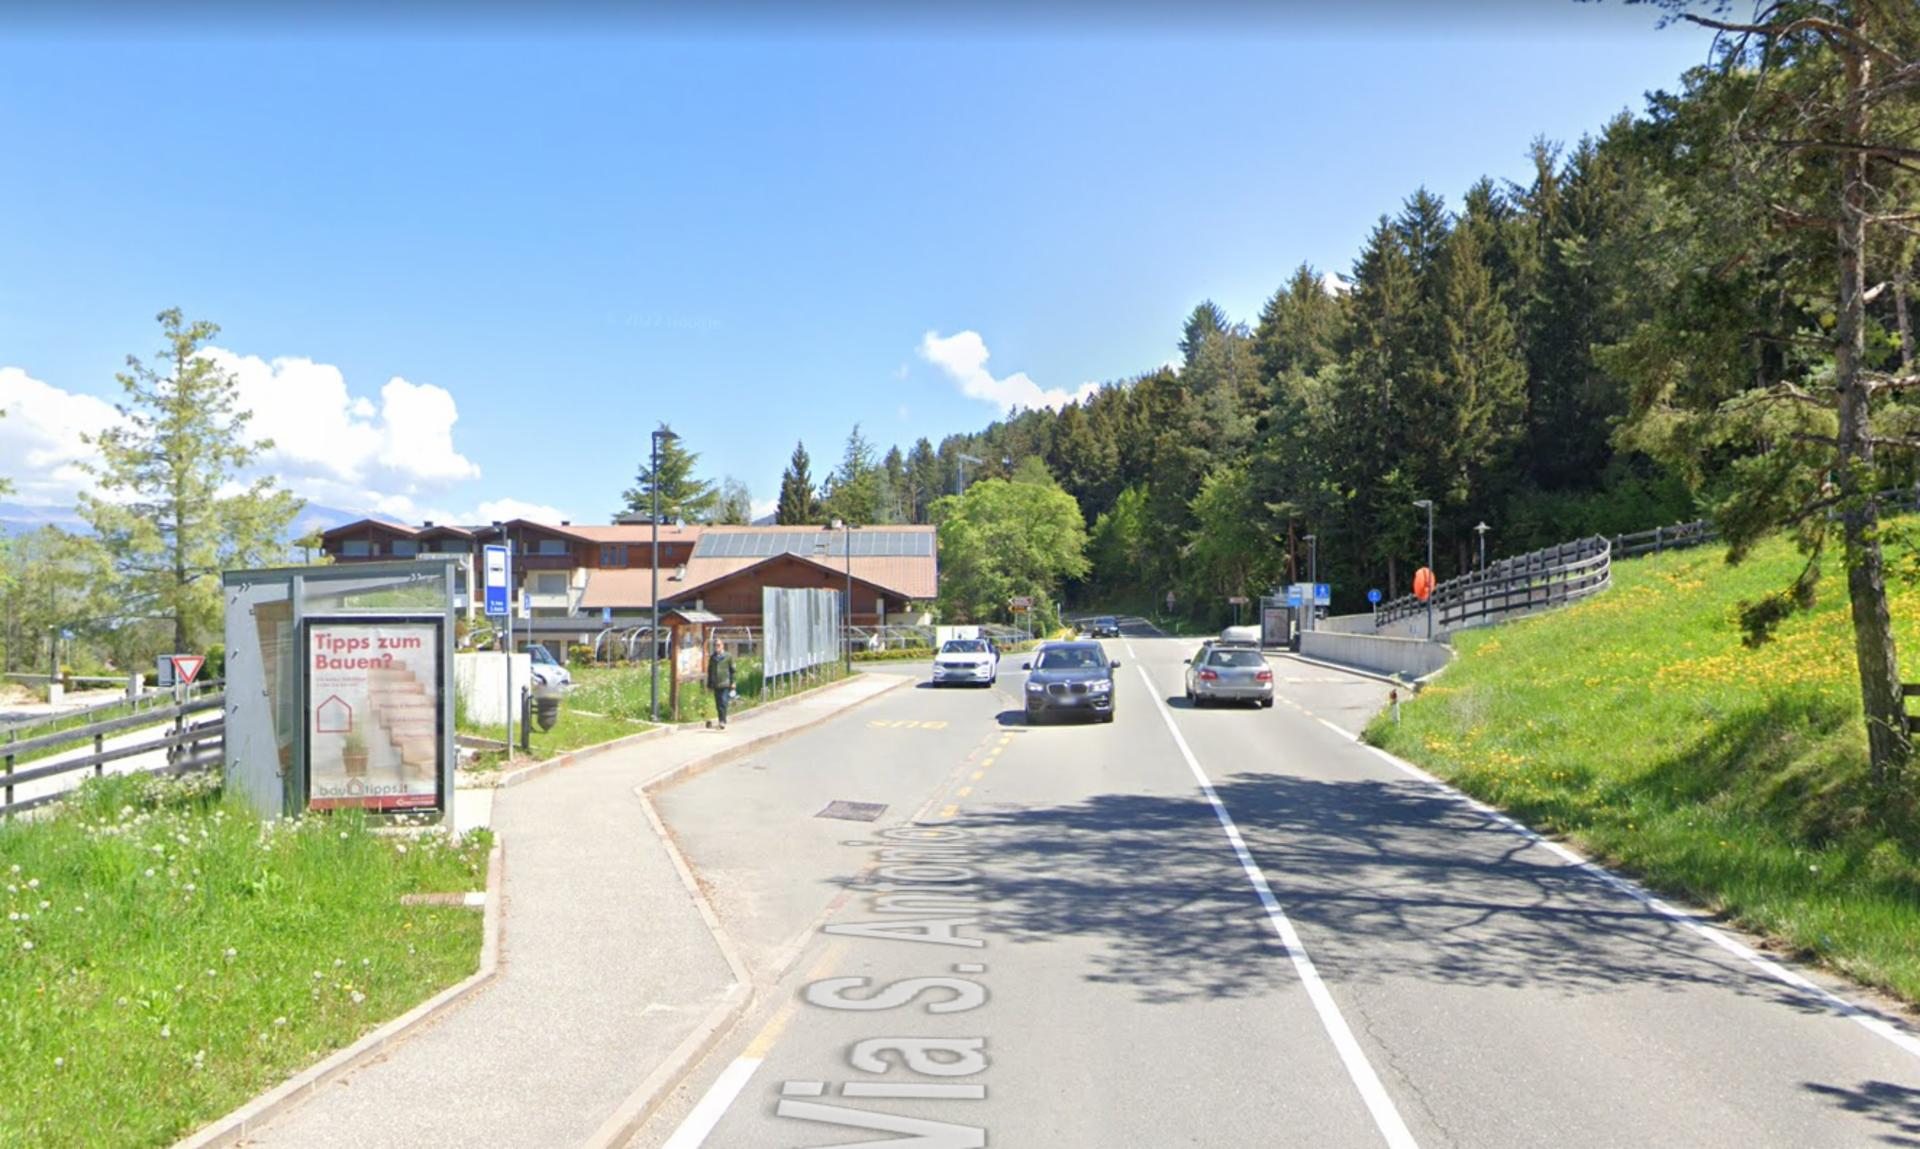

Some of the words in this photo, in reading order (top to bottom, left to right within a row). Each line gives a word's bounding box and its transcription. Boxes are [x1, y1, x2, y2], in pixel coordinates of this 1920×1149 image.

[315, 633, 370, 654] Tipps
[378, 636, 421, 649] zum
[315, 653, 393, 669] Bauen?
